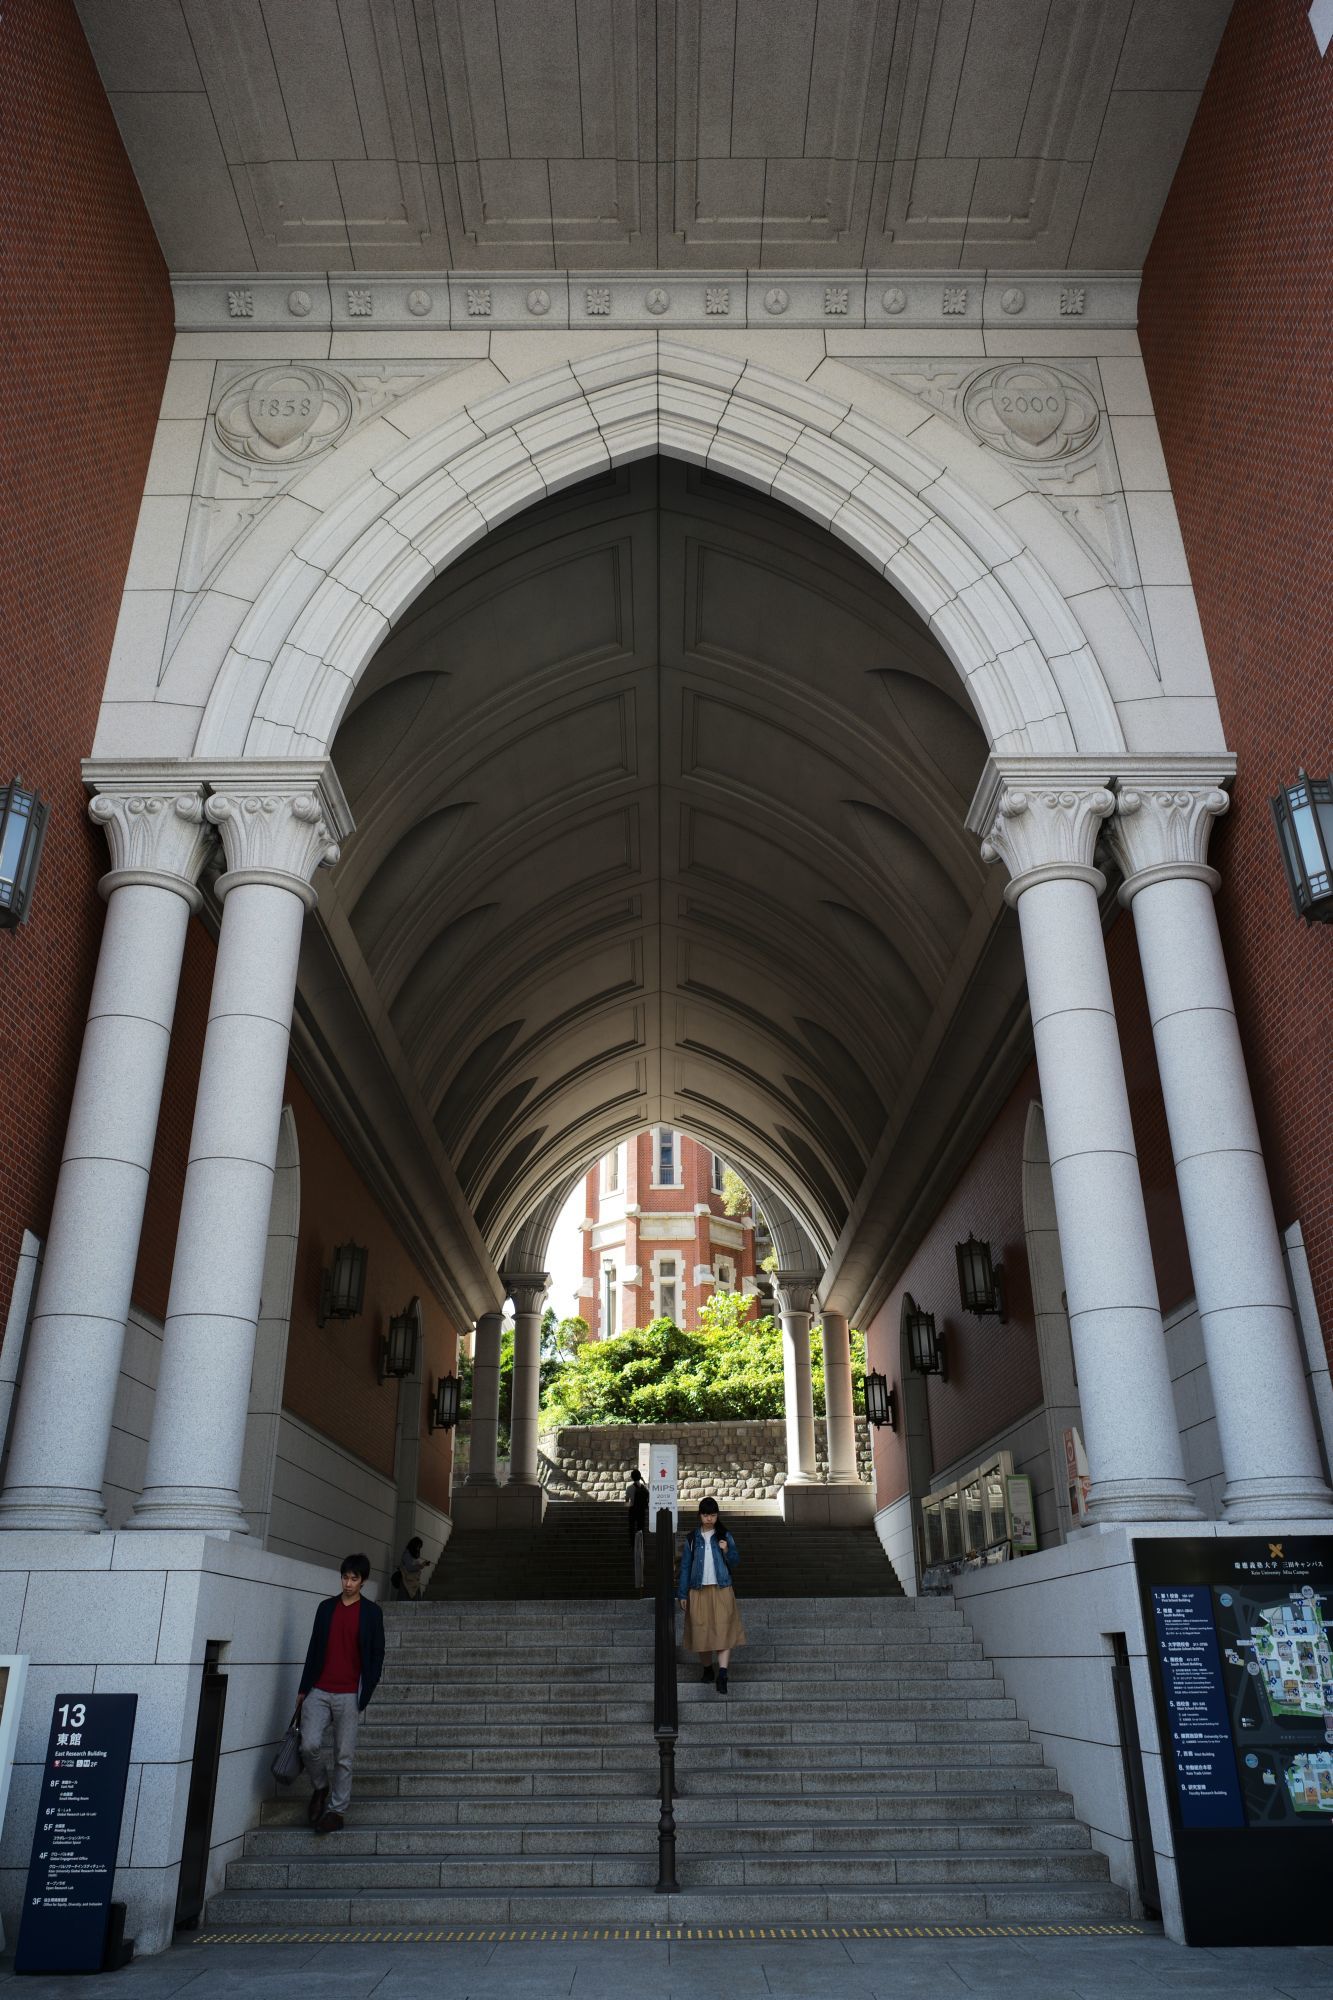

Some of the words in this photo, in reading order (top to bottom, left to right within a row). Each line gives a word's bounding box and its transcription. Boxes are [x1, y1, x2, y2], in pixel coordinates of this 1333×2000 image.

[258, 398, 311, 417] 1858
[1001, 396, 1059, 413] 2000
[652, 1484, 675, 1492] MIPS
[58, 1703, 86, 1728] 13
[56, 1732, 82, 1746] 東館
[87, 1750, 107, 1758] Building
[43, 1823, 53, 1831] 5F
[39, 1852, 48, 1860] 4F
[32, 1897, 41, 1905] 3F
